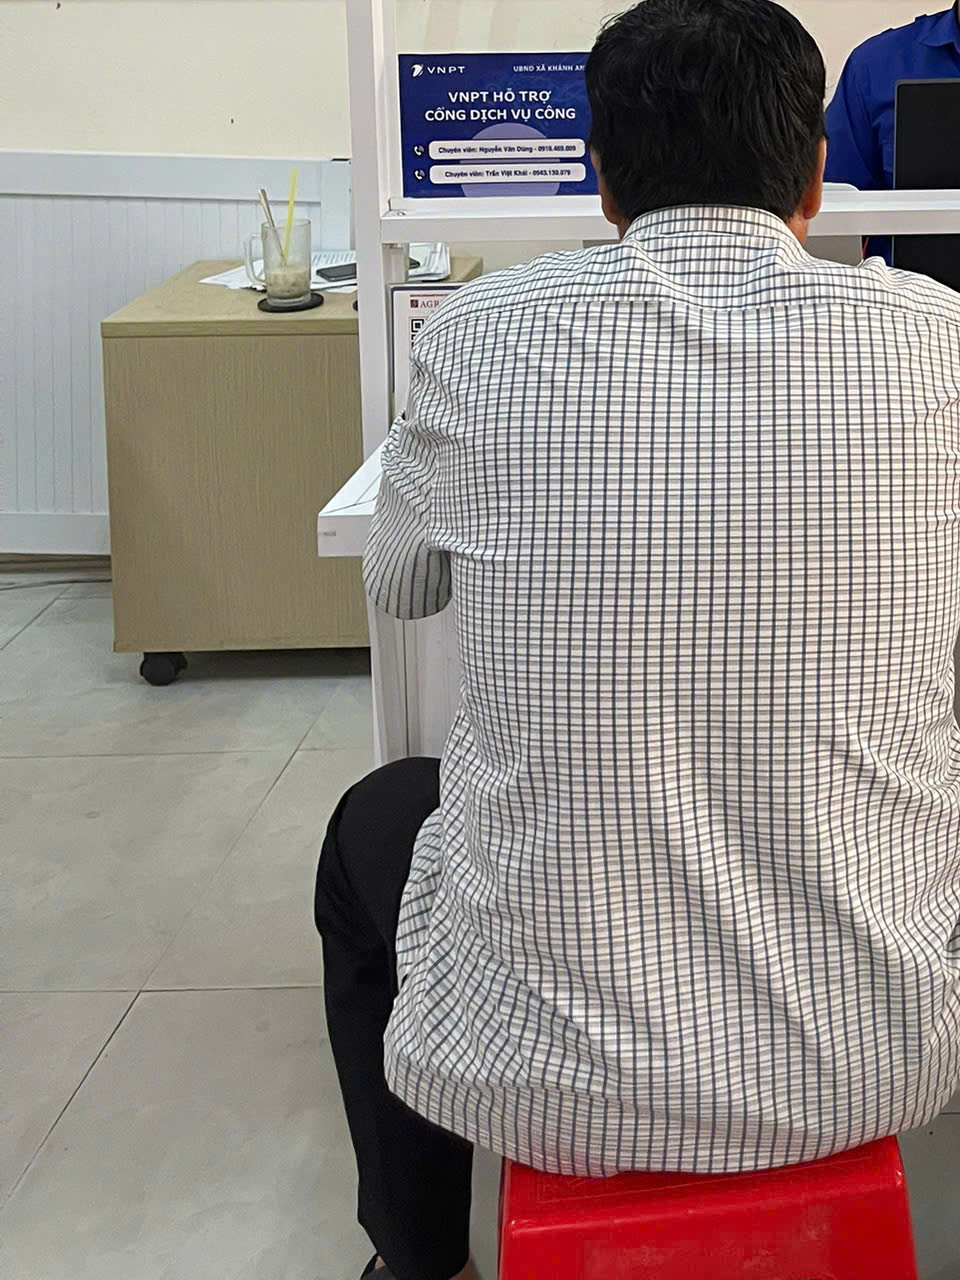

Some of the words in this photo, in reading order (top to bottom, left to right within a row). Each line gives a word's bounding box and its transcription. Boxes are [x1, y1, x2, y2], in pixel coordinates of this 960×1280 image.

[427, 66, 465, 74] VNPT
[547, 63, 574, 72] KHÁNH
[448, 91, 489, 103] VNPT
[493, 87, 515, 102] HỖ
[519, 90, 552, 104] TRỢ
[470, 109, 507, 123] DỊCH
[510, 108, 531, 122] VỤ
[535, 105, 576, 119] CÔNG
